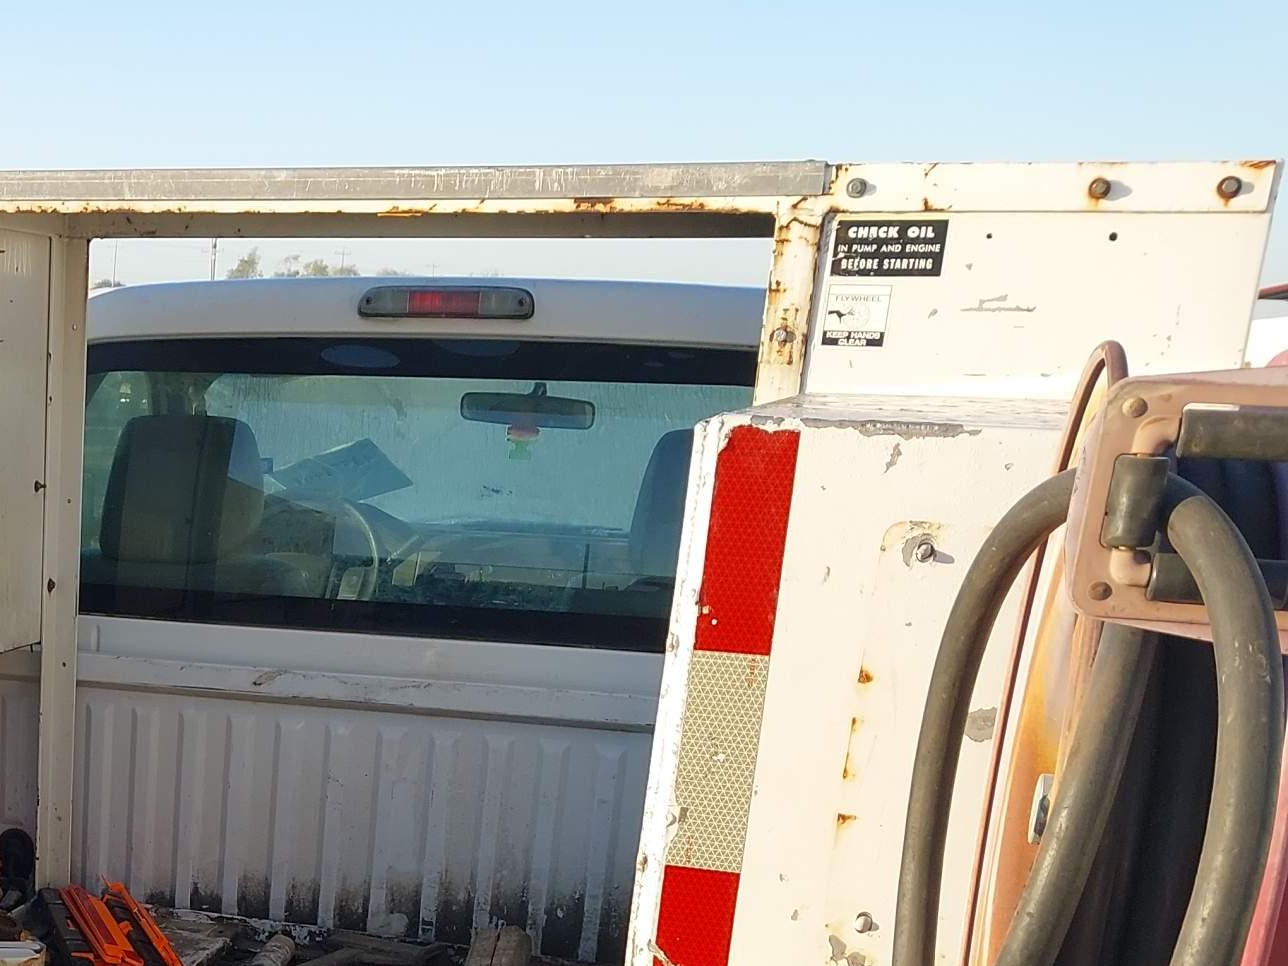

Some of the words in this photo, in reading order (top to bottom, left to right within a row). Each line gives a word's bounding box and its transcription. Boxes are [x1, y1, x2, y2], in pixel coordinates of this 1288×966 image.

[848, 226, 900, 239] CHECK
[907, 226, 936, 239] OIL
[838, 244, 849, 252] IN
[852, 244, 877, 252] PUMP
[880, 244, 902, 252] AND
[905, 244, 941, 252] ENGINE
[840, 258, 879, 270] BEFORE
[883, 258, 933, 270] STARTING
[835, 295, 882, 303] FLYWHEEL
[826, 331, 849, 339] KEEP
[850, 331, 881, 339] HANDS
[837, 338, 867, 346] CLEAR
